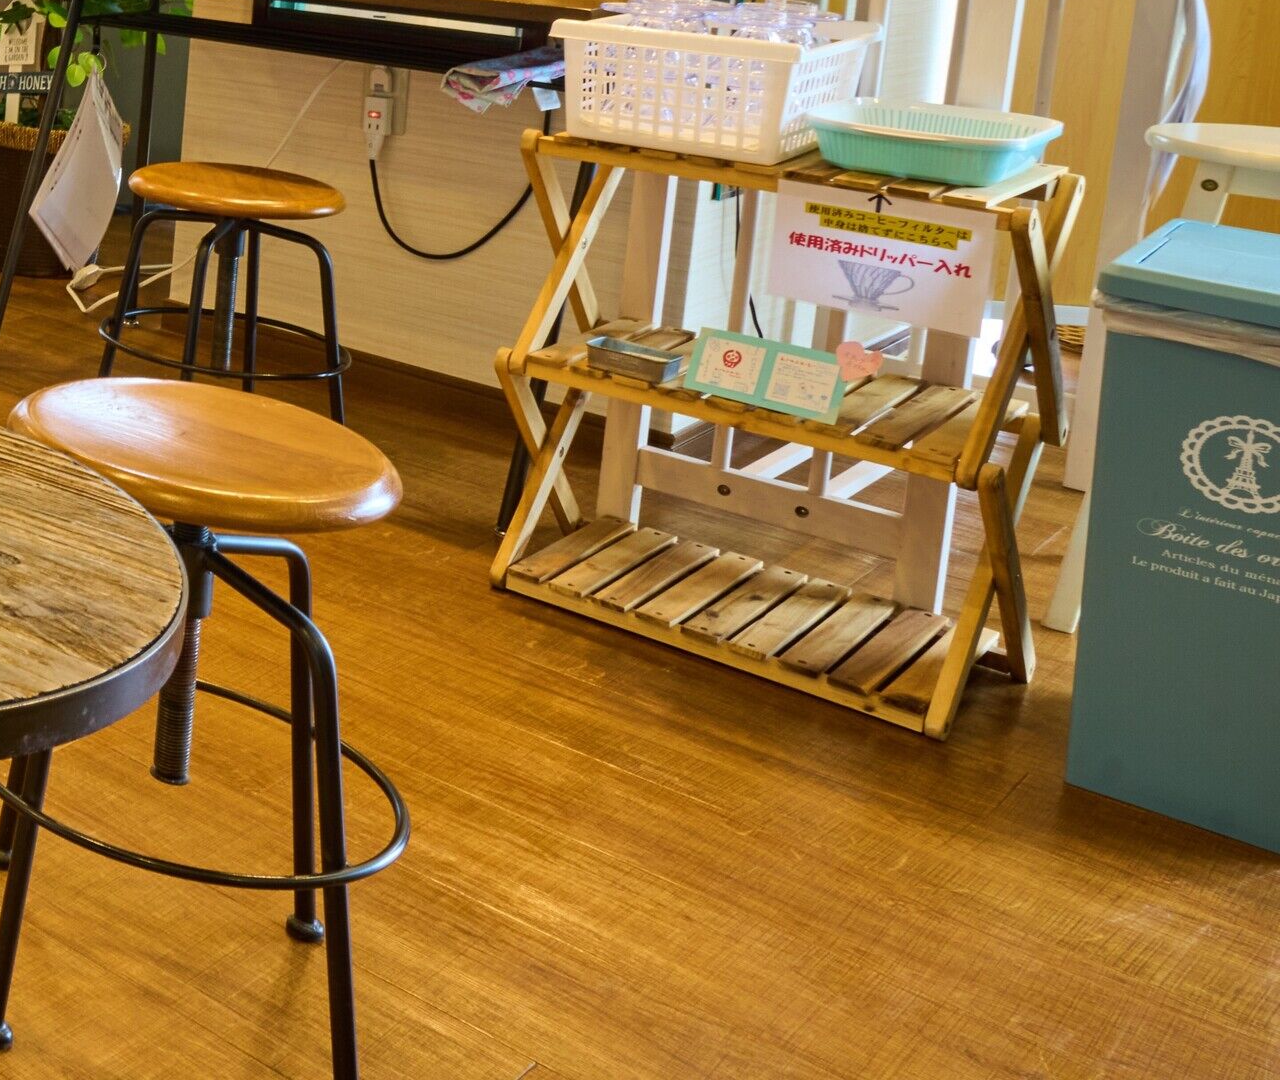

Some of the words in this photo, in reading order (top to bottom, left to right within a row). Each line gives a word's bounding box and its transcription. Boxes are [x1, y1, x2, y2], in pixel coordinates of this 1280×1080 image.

[18, 74, 53, 91] HONEY
[808, 204, 969, 240] 使用済みコーヒーフィルターは
[823, 217, 955, 249] 中身は捨てずにこちらへ
[788, 230, 972, 278] 使用済みドリッパー入れ
[1161, 549, 1217, 569] Articles
[1220, 563, 1241, 575] du
[1215, 539, 1252, 558] des
[1131, 555, 1147, 567] Le
[1150, 563, 1199, 581] produit
[1214, 576, 1236, 590] fait
[1239, 585, 1256, 595] au
